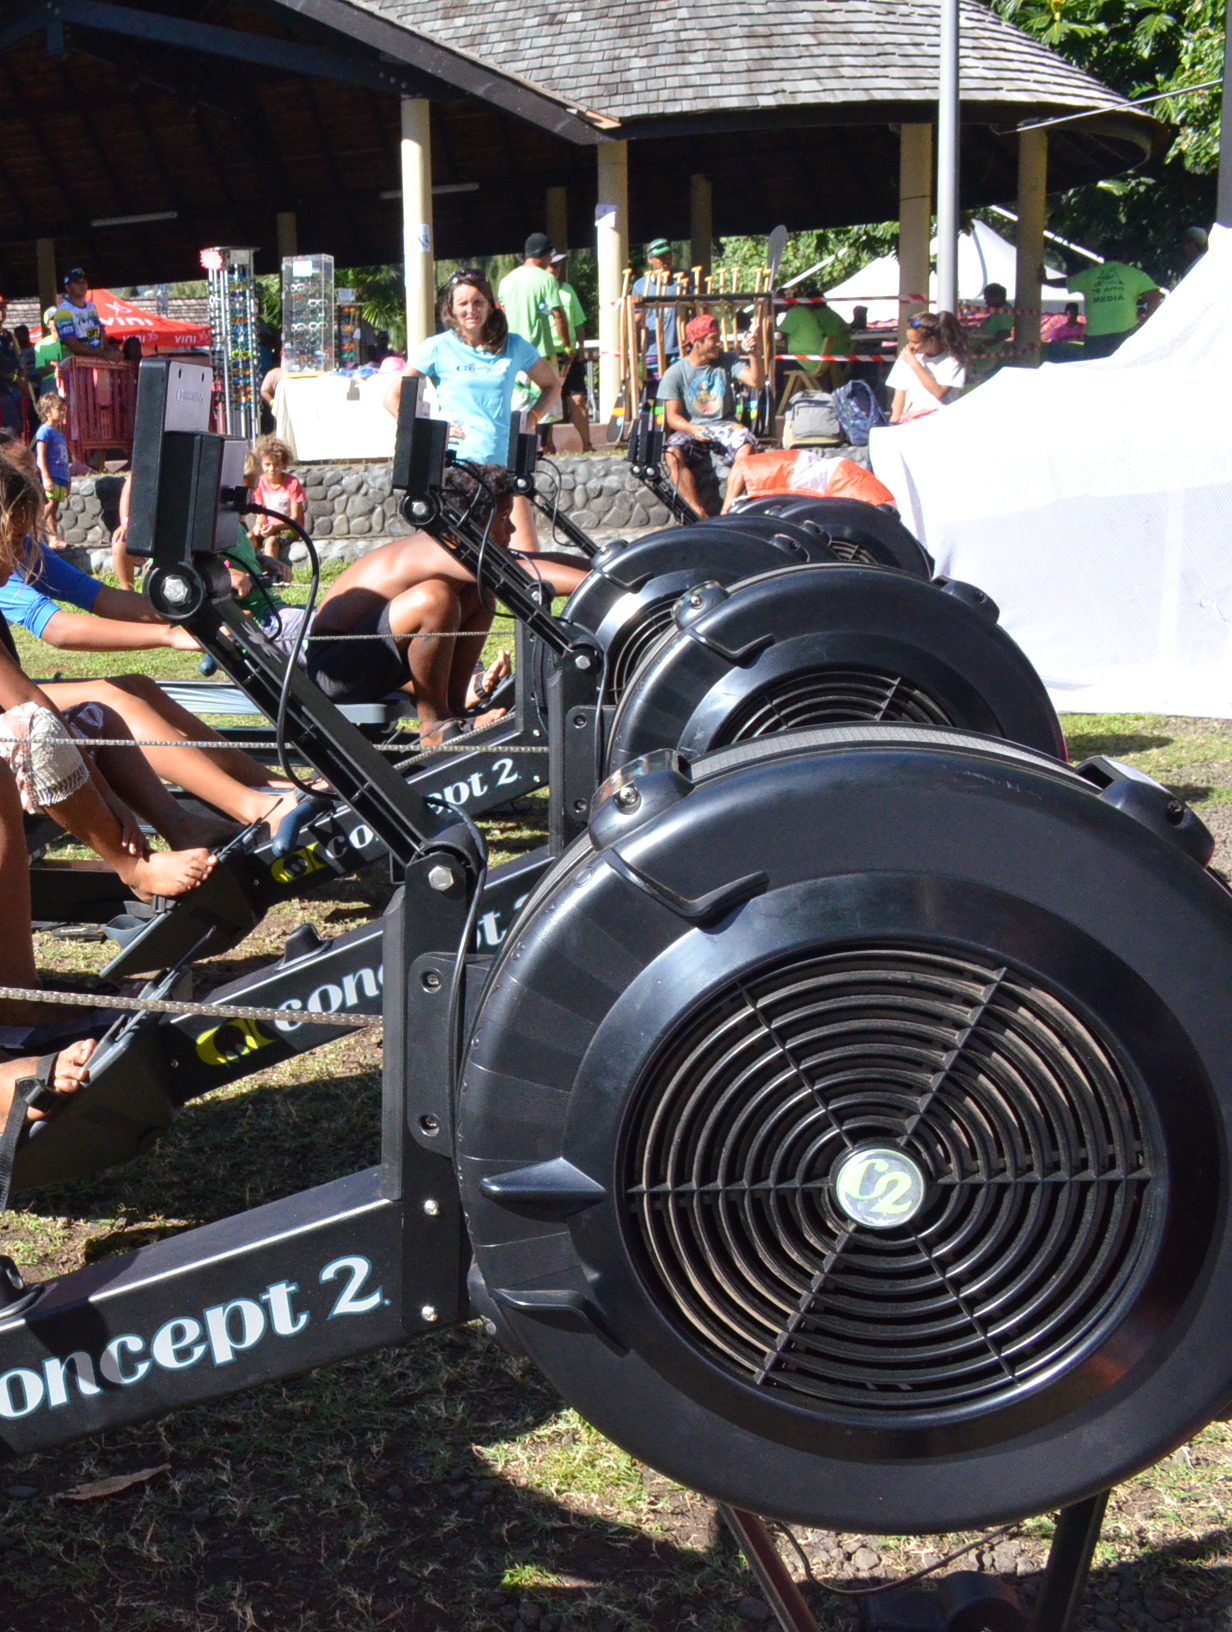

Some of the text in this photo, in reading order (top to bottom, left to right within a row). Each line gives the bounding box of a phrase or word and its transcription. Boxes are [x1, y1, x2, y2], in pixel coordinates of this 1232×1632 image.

[1093, 295, 1125, 304] MEDIA
[492, 757, 519, 788] 2
[845, 1158, 913, 1215] C2
[319, 1254, 384, 1321] 2
